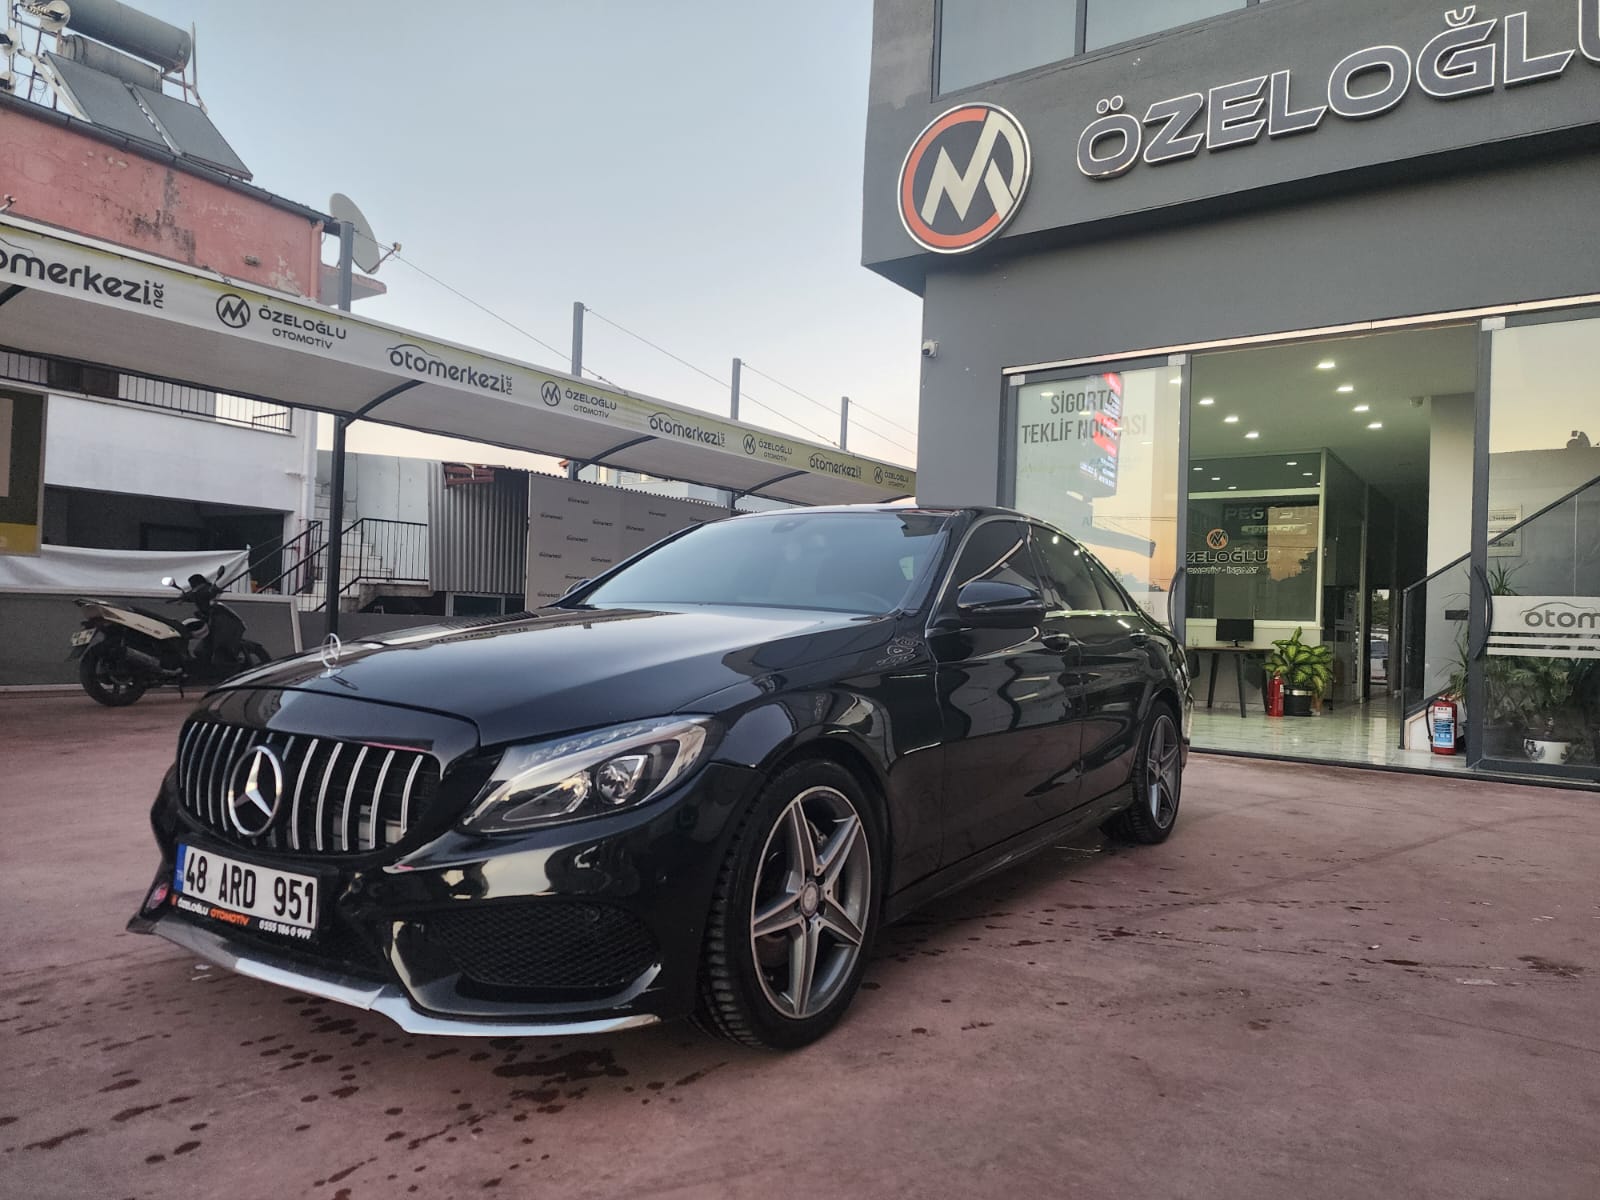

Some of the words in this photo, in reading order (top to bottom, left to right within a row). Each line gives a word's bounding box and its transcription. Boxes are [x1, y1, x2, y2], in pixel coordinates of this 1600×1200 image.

[1077, 0, 1600, 179] ÖZELOĞL
[259, 304, 346, 339] ÖZELOĞLU
[272, 328, 333, 349] OTOMOTİV
[1022, 418, 1073, 444] TEKLİF
[186, 852, 208, 894] 48
[219, 863, 256, 908] ARD
[273, 876, 314, 924] 951
